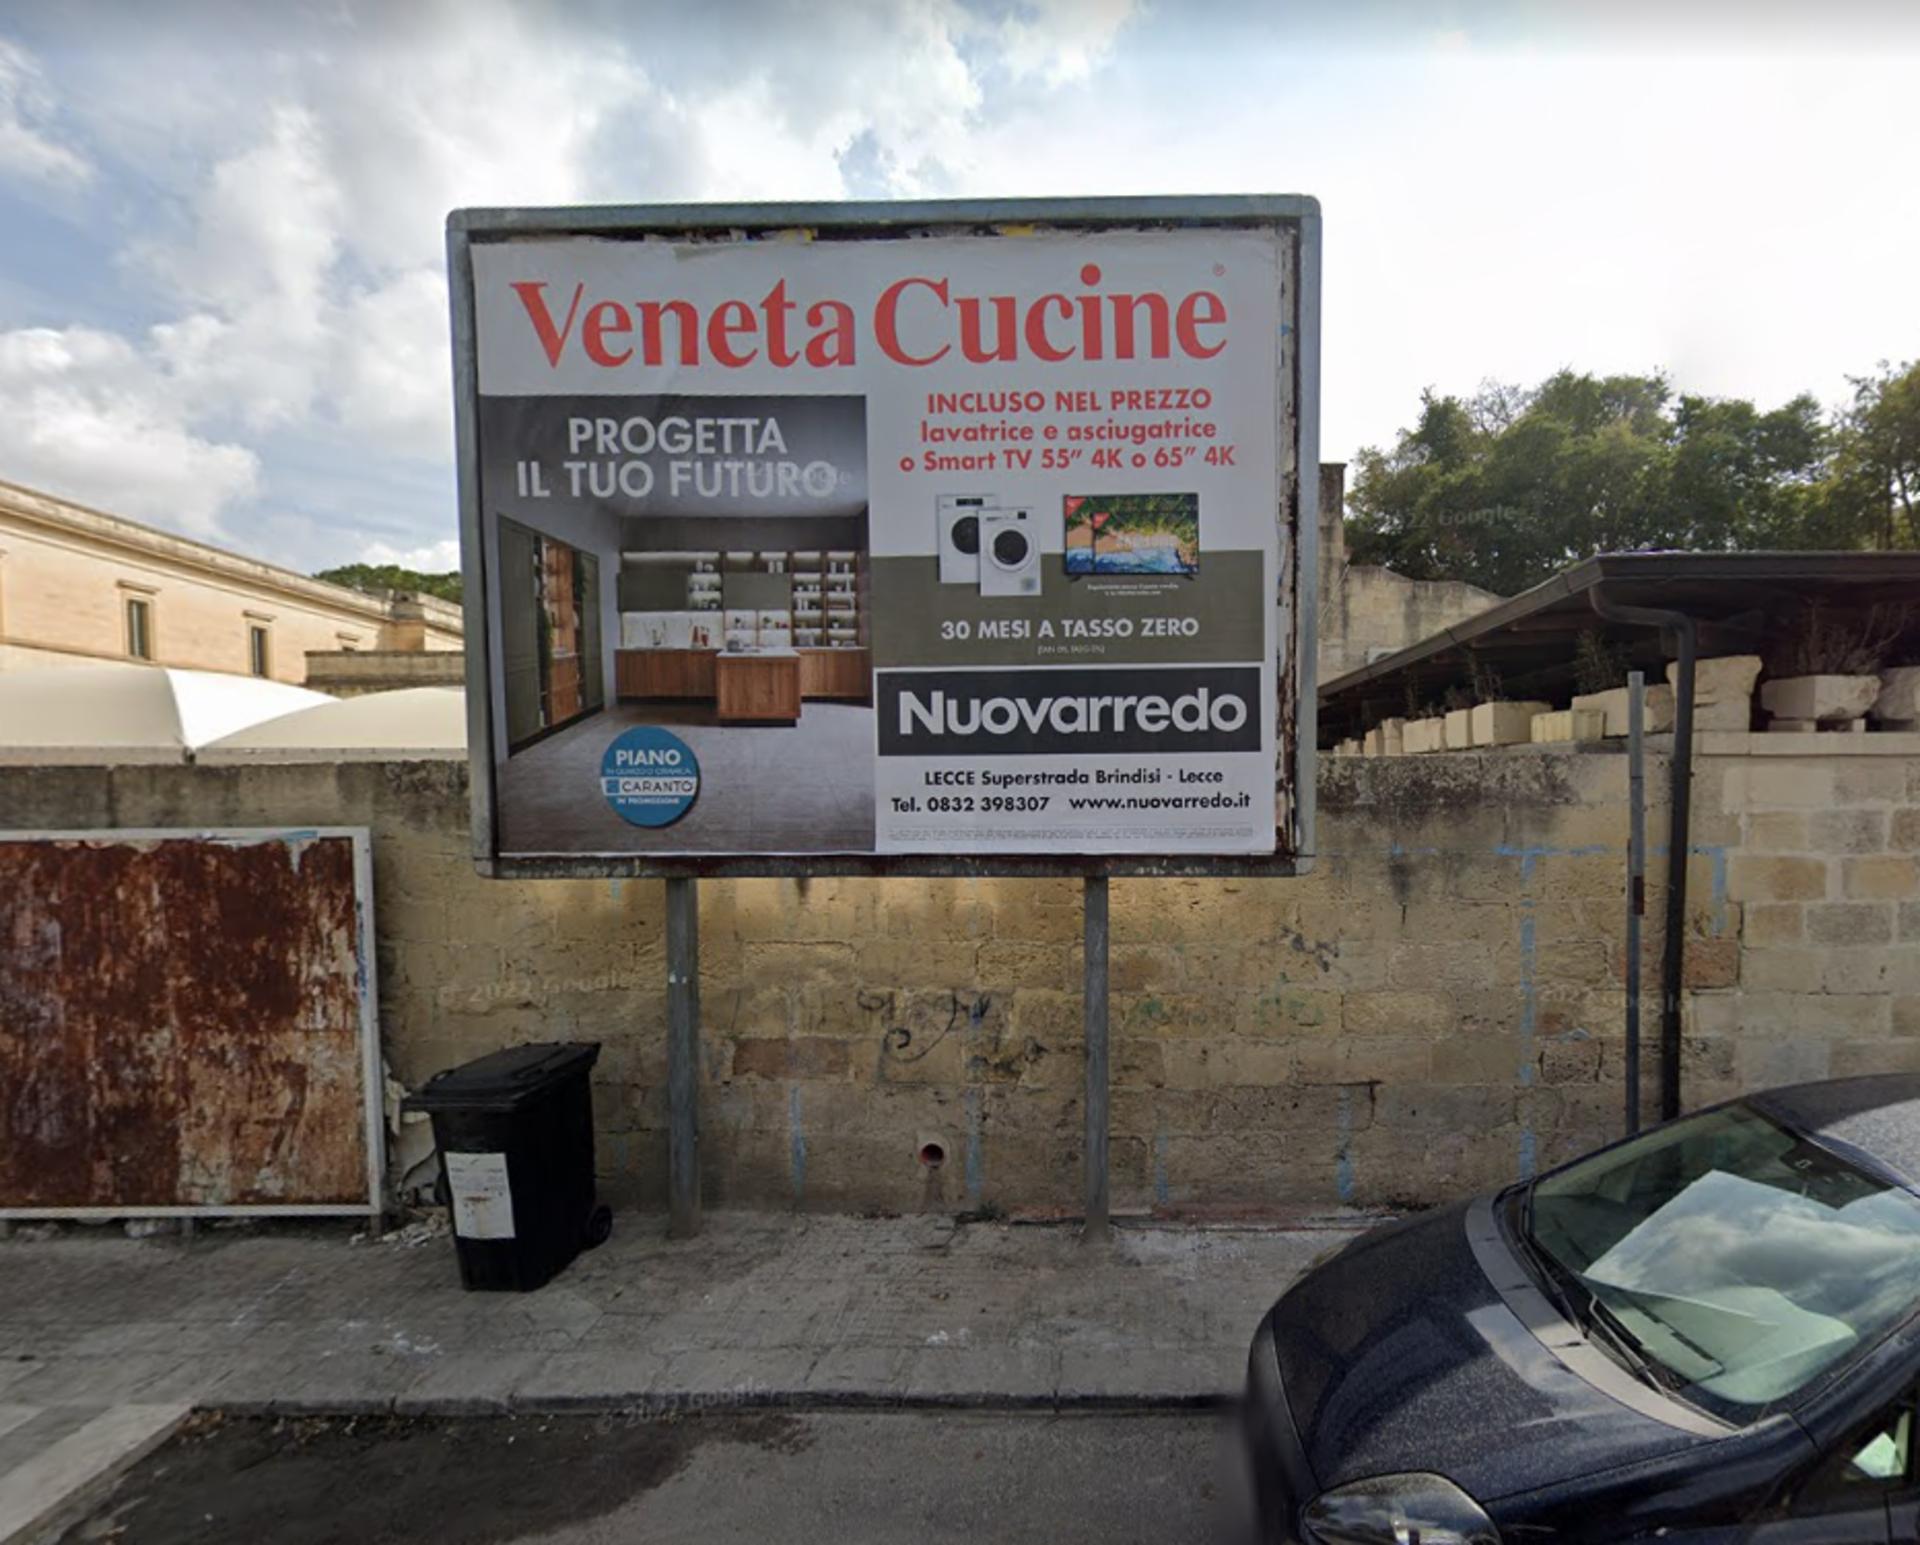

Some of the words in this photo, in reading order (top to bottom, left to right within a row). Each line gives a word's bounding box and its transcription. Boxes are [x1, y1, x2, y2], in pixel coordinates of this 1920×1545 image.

[510, 278, 856, 368] Veneta
[874, 264, 1227, 367] Cucine
[928, 390, 1045, 414] INCLUSO
[1055, 390, 1102, 413] NEL
[1110, 387, 1212, 411] PREZZO
[568, 416, 788, 455] PROGETTA
[920, 419, 1034, 442] lavatrice
[1043, 425, 1058, 440] e
[1067, 416, 1217, 445] asciugatrice
[900, 457, 915, 472] o
[923, 450, 996, 471] Smart
[1003, 449, 1032, 469] TV
[1091, 448, 1123, 469] 4K
[1131, 453, 1146, 468] o
[1204, 445, 1235, 466] 4K
[516, 461, 551, 498] IL
[563, 460, 655, 498] TUO
[669, 460, 837, 498] FUTURO
[941, 620, 971, 640] 30
[978, 619, 1030, 639] MESI
[1037, 619, 1055, 638] A
[1061, 618, 1134, 638] TASSO
[1140, 617, 1200, 637] ZERO
[899, 688, 1248, 735] Nuovarredo
[615, 749, 682, 766] PIANO
[621, 780, 694, 793] CARANTO
[924, 770, 976, 786] LECCE
[981, 768, 1090, 789] Superstrada
[1095, 768, 1161, 784] Brindisi
[1179, 769, 1224, 784] Lecce
[891, 797, 922, 813] Tel.
[926, 796, 976, 813] 0832
[980, 796, 1051, 813] 398307
[1068, 791, 1252, 810] www.nuovarredo.it
